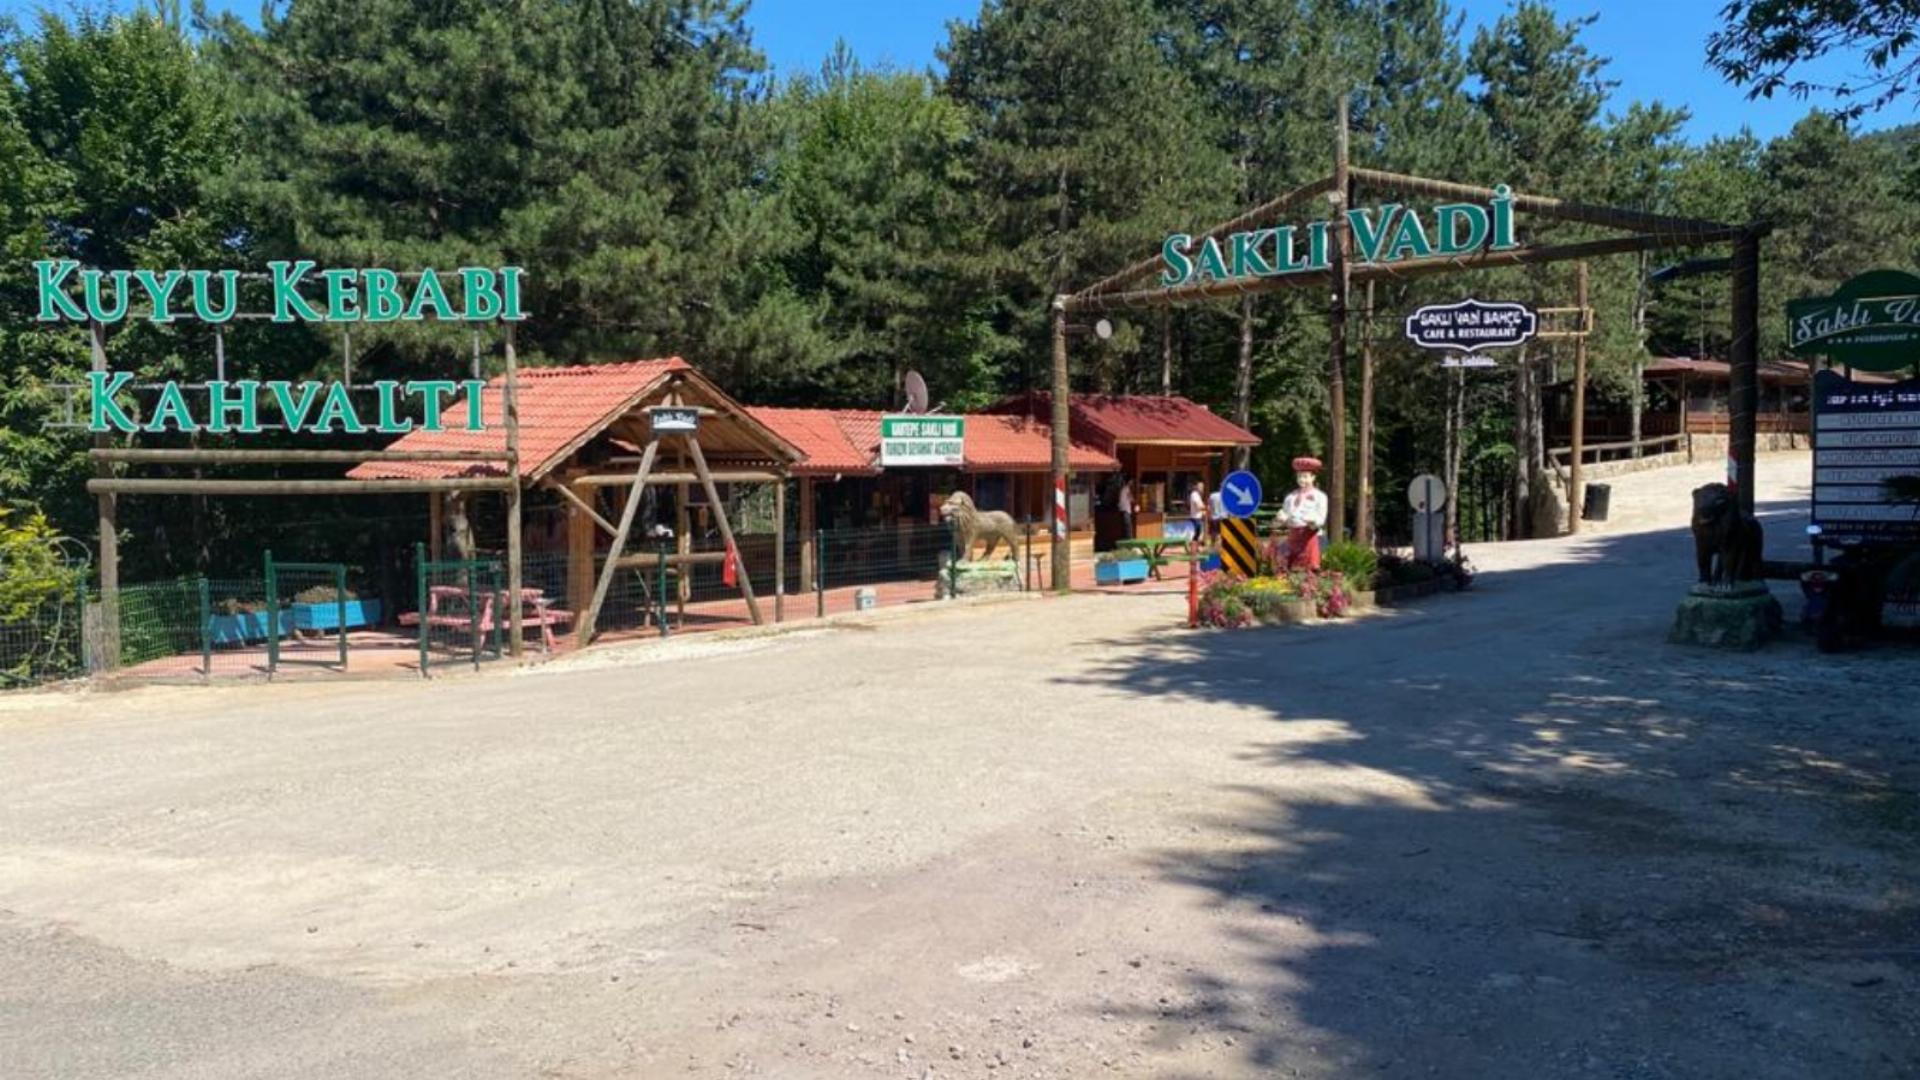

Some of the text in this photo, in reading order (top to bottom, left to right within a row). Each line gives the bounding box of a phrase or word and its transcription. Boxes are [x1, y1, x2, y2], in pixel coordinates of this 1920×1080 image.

[1161, 183, 1520, 287] SAKLI VADİ
[33, 259, 526, 323] KUYU KEBABI
[1423, 327, 1517, 339] CAFE & RESTAURANT
[86, 371, 487, 433] KAHVALTI
